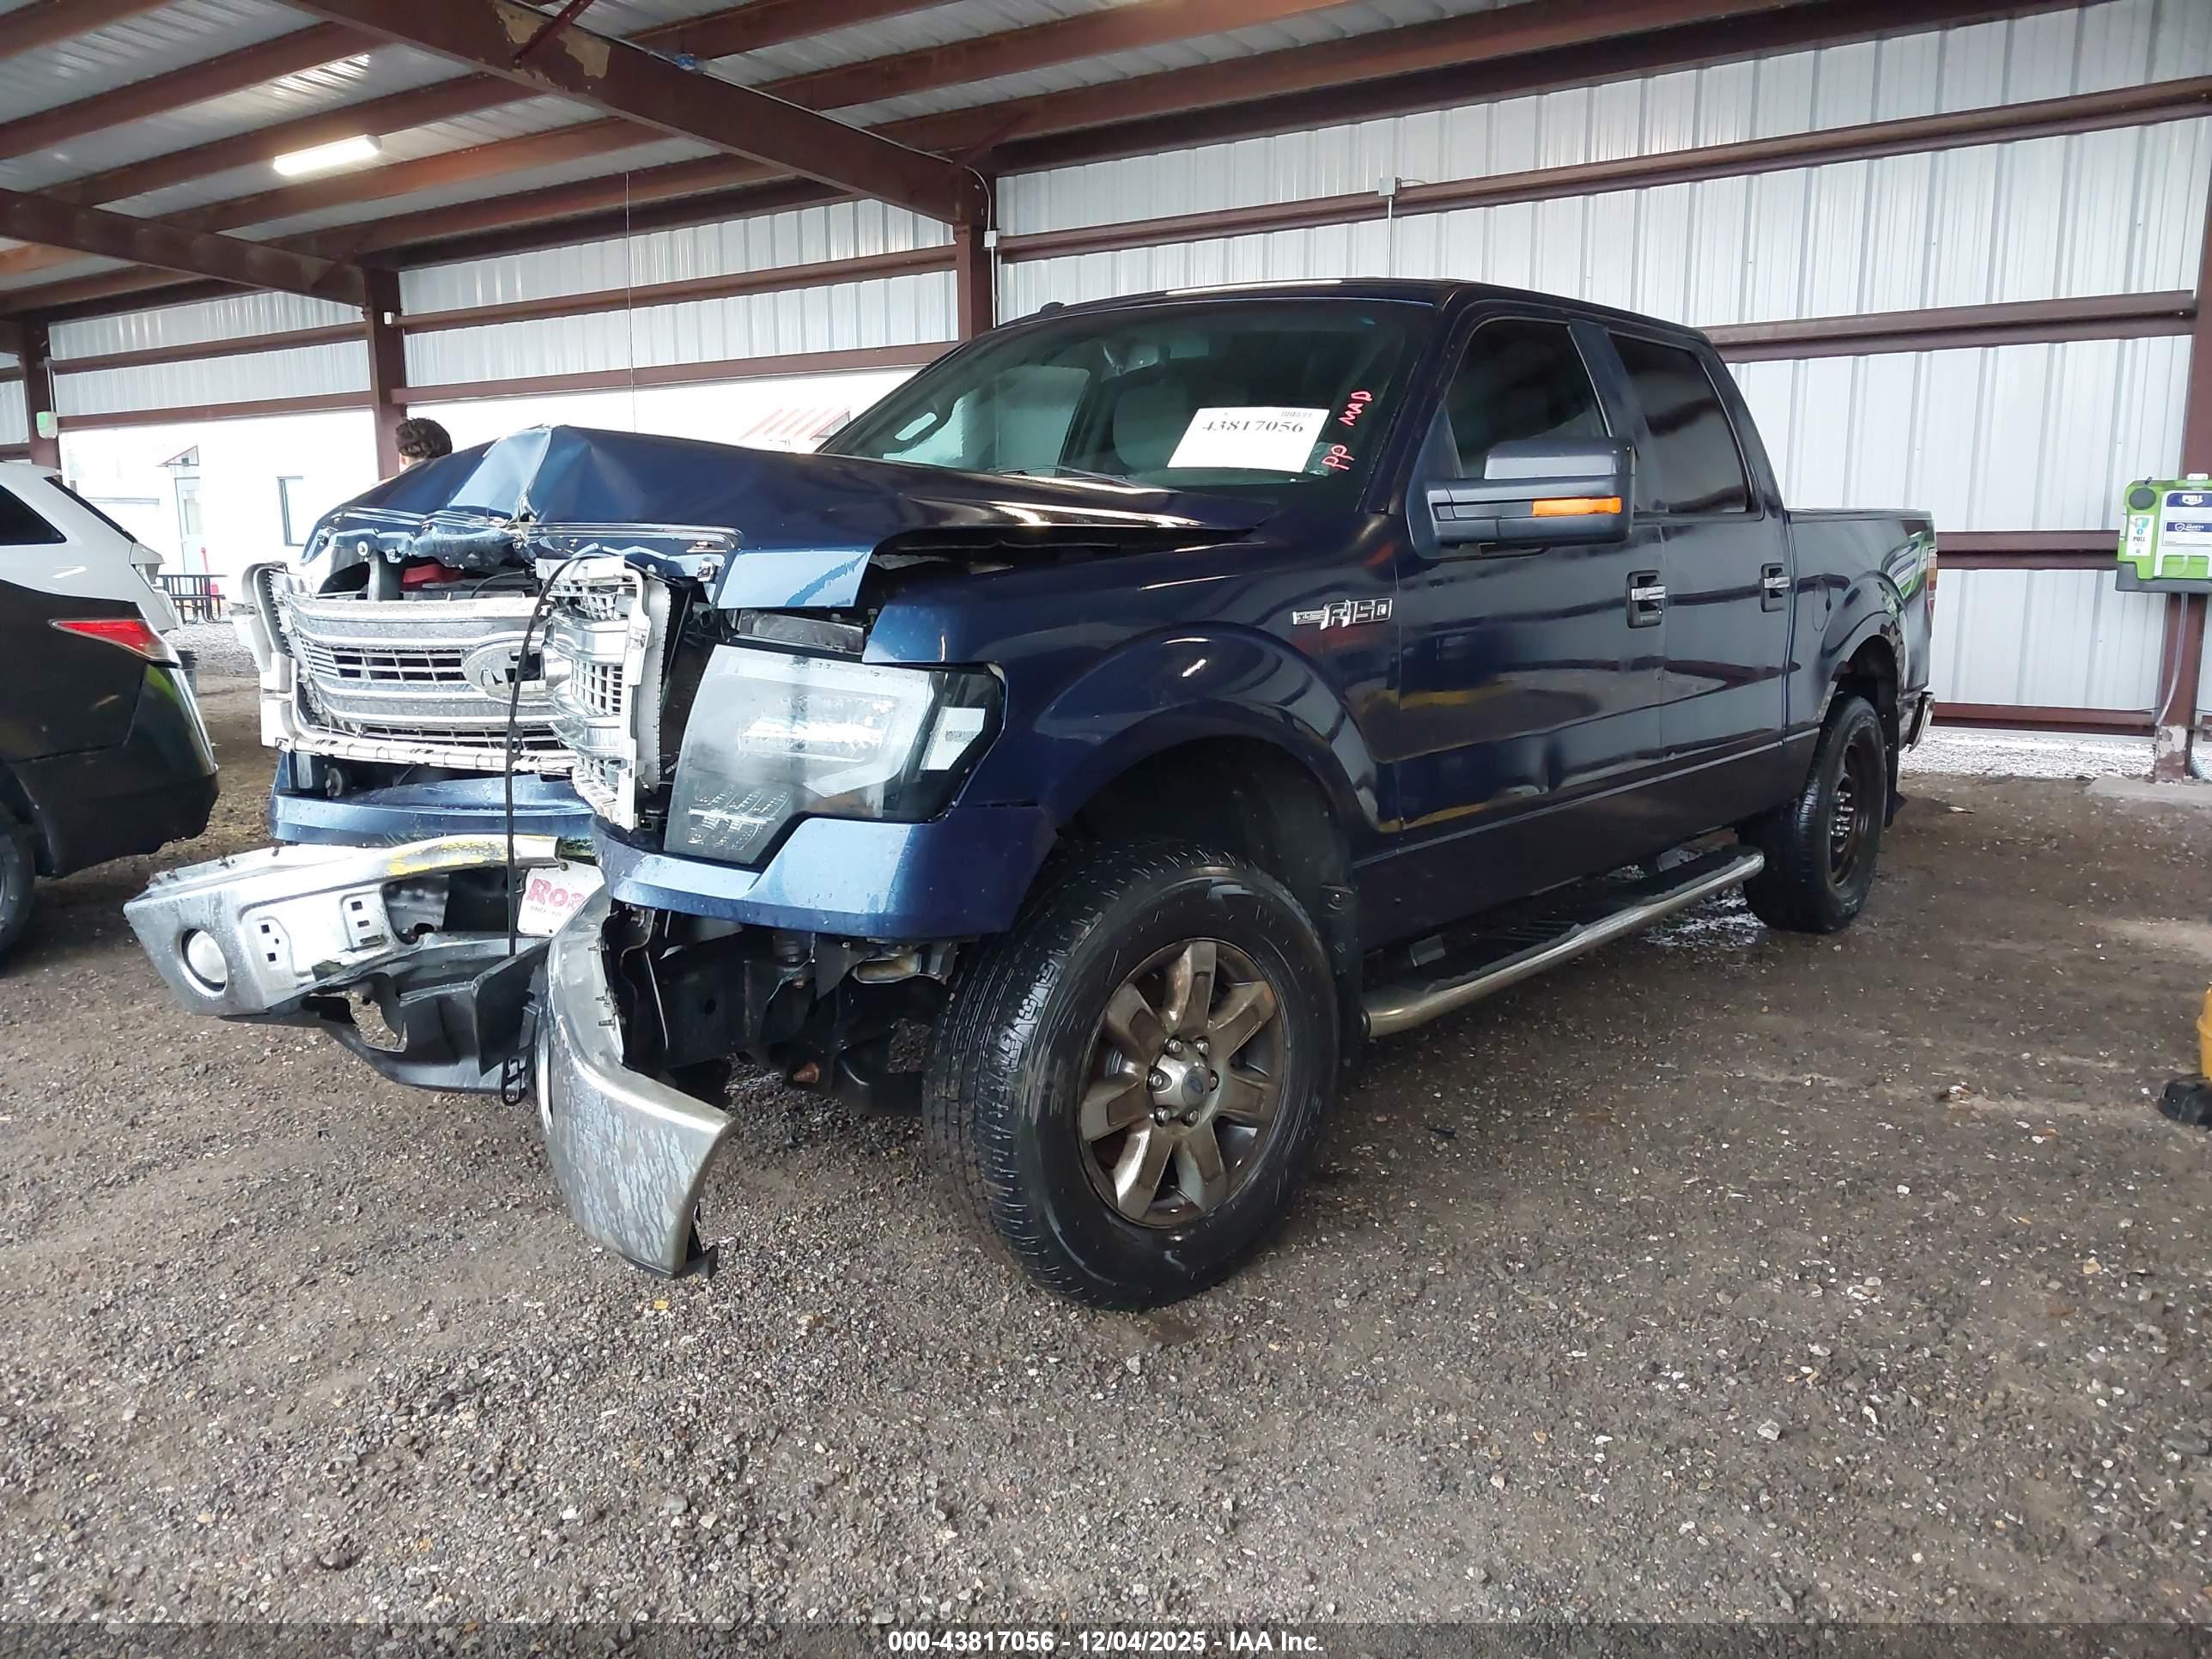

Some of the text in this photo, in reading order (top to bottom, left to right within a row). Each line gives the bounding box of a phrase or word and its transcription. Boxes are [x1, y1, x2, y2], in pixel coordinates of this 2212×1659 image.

[1338, 390, 1373, 427] MAD
[1202, 420, 1305, 434] 43817056
[1297, 613, 1311, 622] XLT
